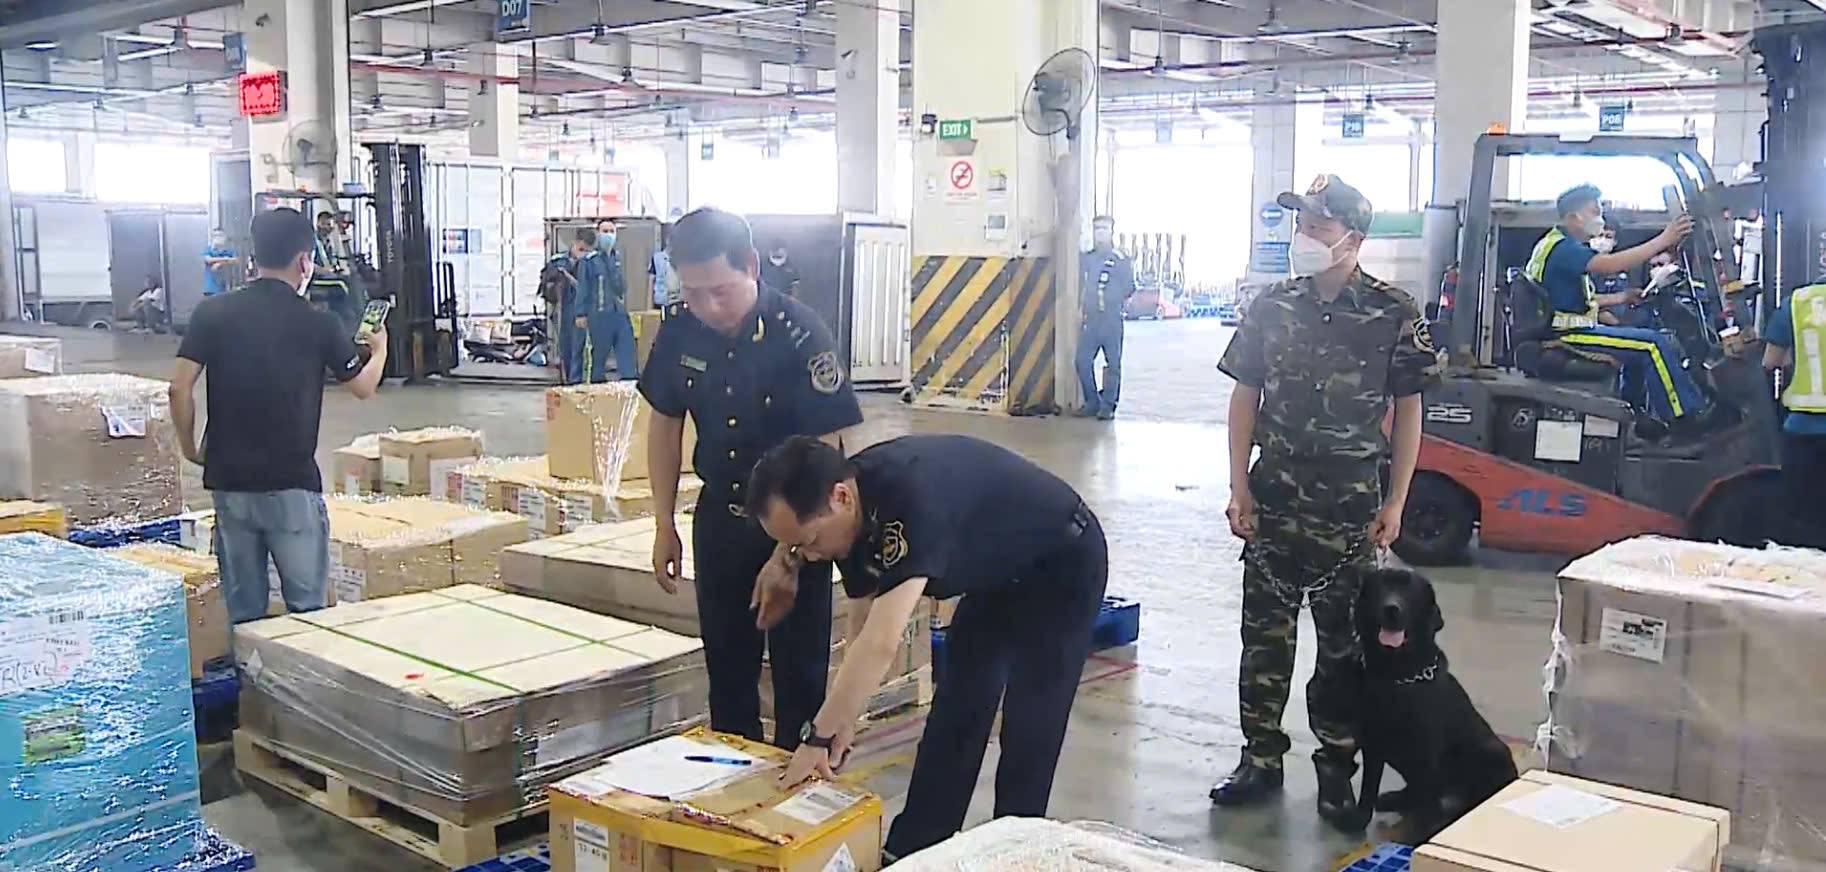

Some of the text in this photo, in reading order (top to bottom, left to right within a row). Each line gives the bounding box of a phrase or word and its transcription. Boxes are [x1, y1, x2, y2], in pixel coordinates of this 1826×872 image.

[943, 123, 961, 136] EXIT
[1427, 406, 1472, 423] 25
[1497, 489, 1584, 517] ALS
